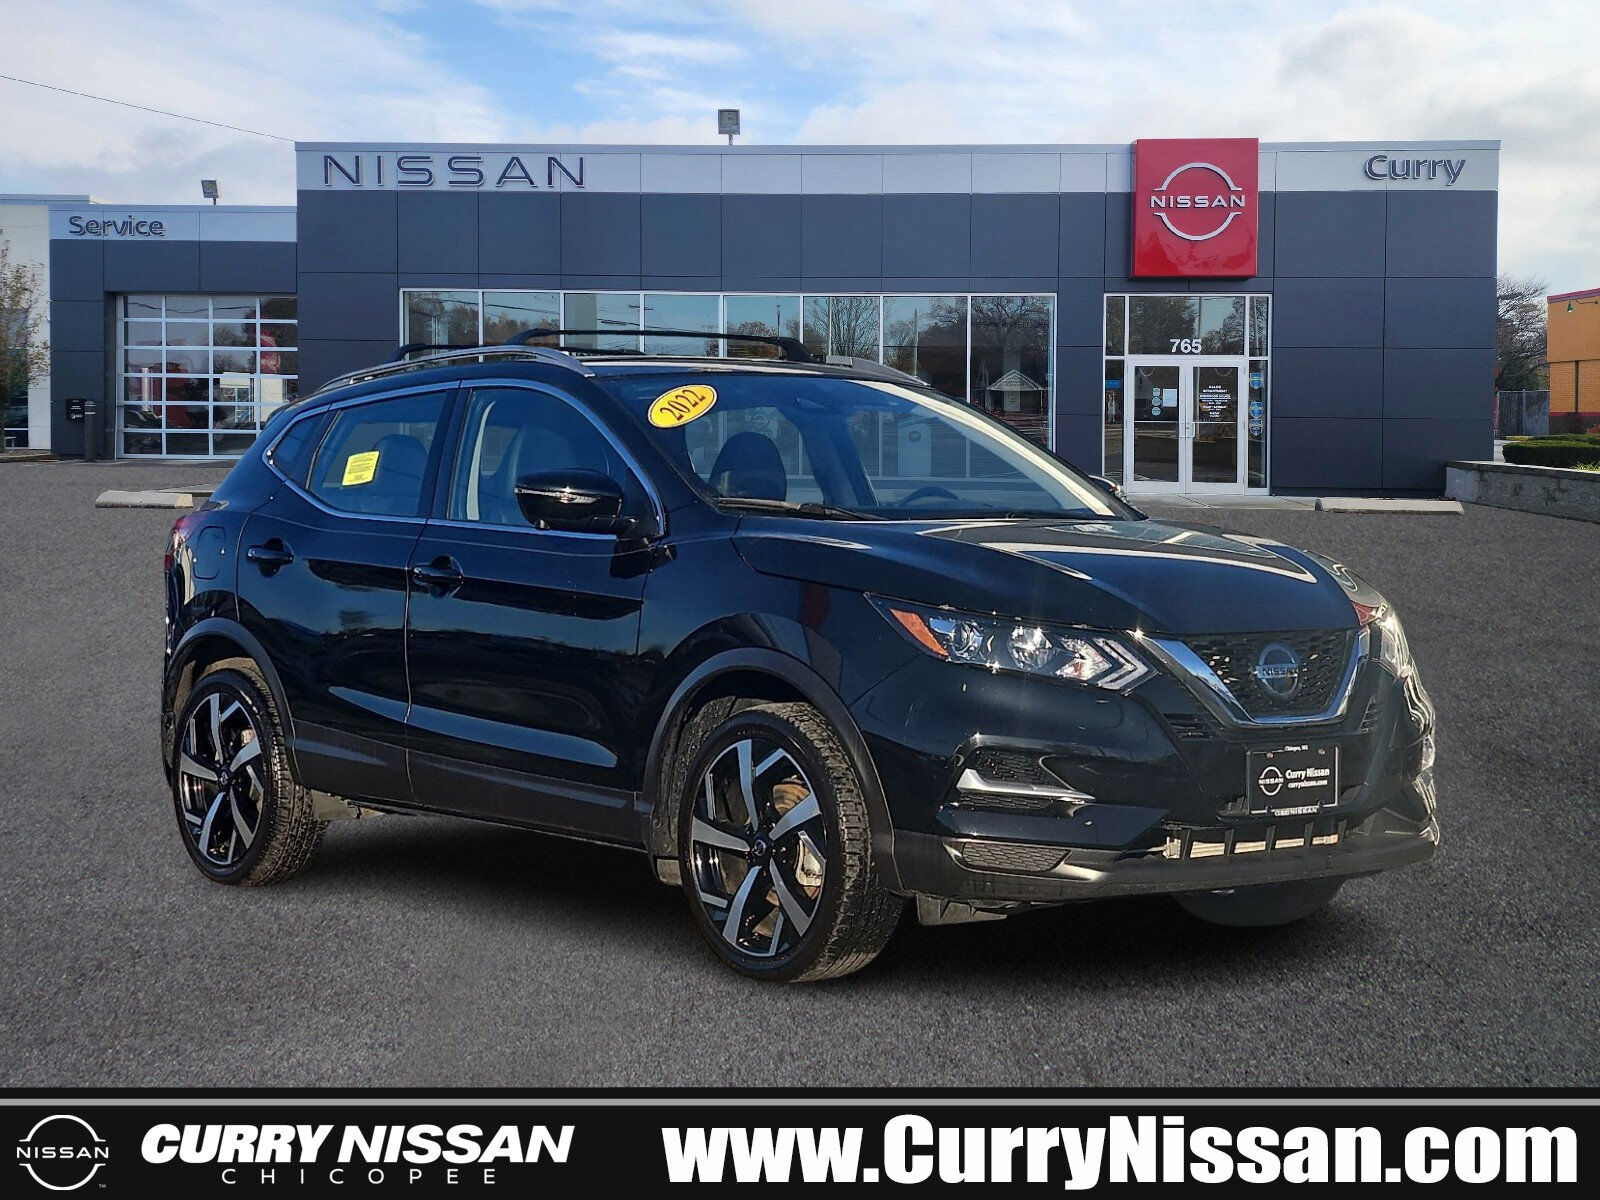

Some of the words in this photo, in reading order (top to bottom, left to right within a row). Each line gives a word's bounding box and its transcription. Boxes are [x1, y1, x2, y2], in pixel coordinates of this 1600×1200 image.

[323, 155, 586, 189] NISSAN
[1364, 154, 1467, 187] Curry
[1149, 194, 1246, 208] NISSAN
[69, 214, 166, 237] Service
[1169, 338, 1202, 354] 765
[659, 389, 706, 422] 2022
[1261, 666, 1299, 676] NISSAN
[1258, 777, 1284, 785] NISSAN
[1285, 769, 1306, 780] Curry
[1306, 767, 1331, 778] Nissan
